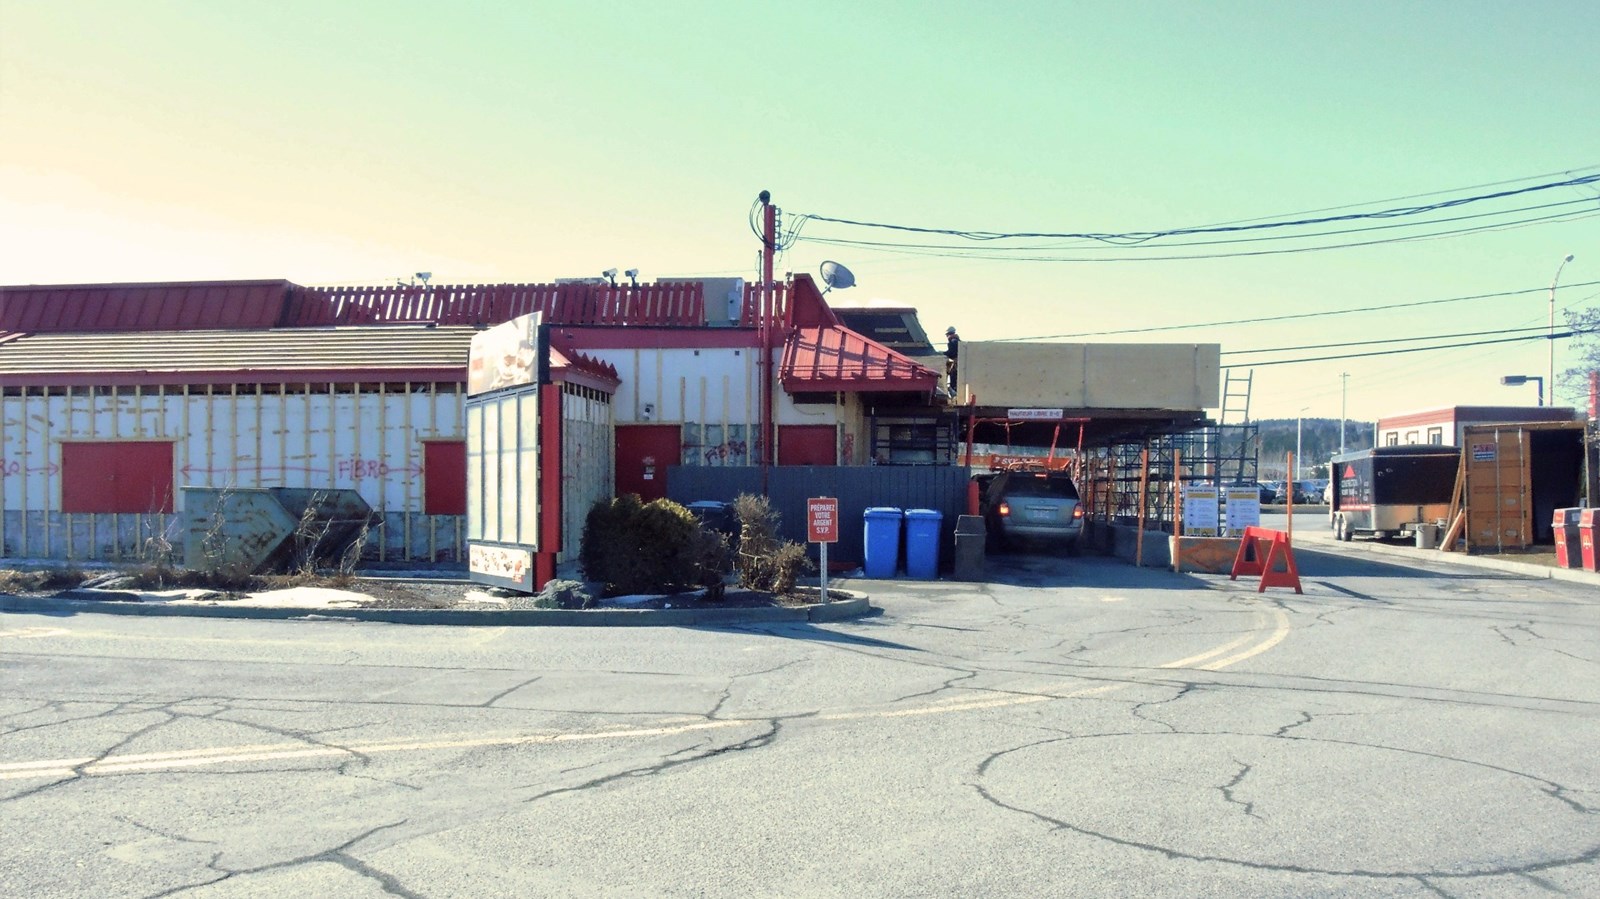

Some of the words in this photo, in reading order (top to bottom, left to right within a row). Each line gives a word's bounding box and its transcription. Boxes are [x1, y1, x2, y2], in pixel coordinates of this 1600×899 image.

[810, 503, 835, 511] PRÉPAREZ
[814, 511, 831, 519] VOTRE
[816, 526, 830, 534] S.V.P.
